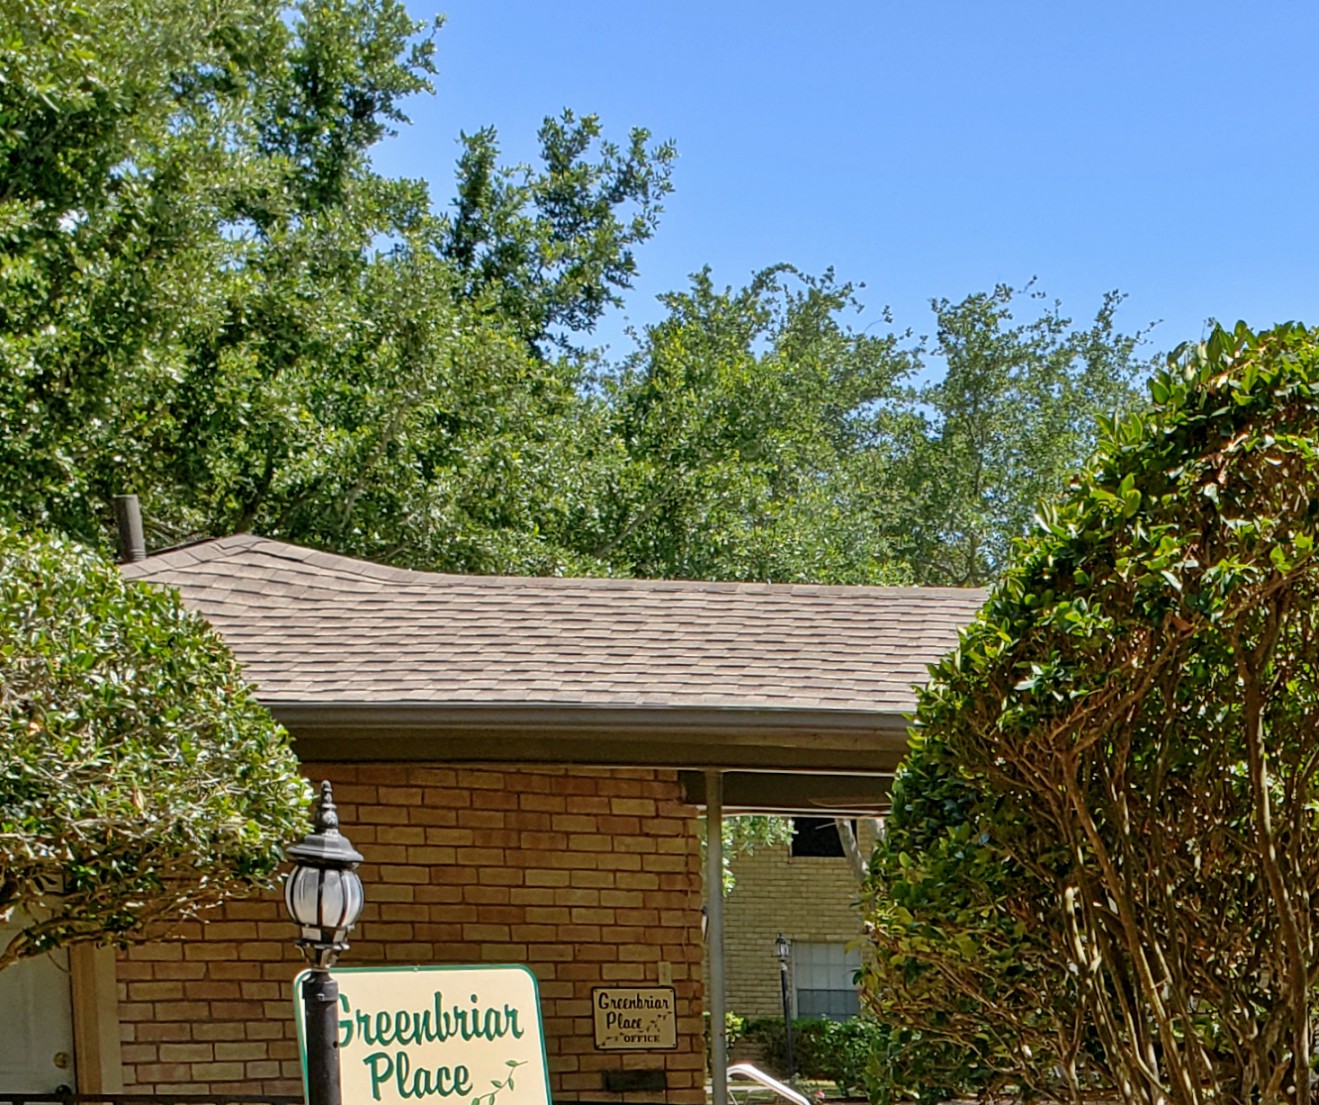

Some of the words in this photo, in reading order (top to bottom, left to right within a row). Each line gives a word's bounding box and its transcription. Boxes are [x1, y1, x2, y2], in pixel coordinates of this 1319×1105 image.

[598, 992, 669, 1009] Greenbriar
[606, 1011, 642, 1030] Place
[623, 1035, 660, 1043] OFFICE
[363, 1051, 473, 1101] Place
